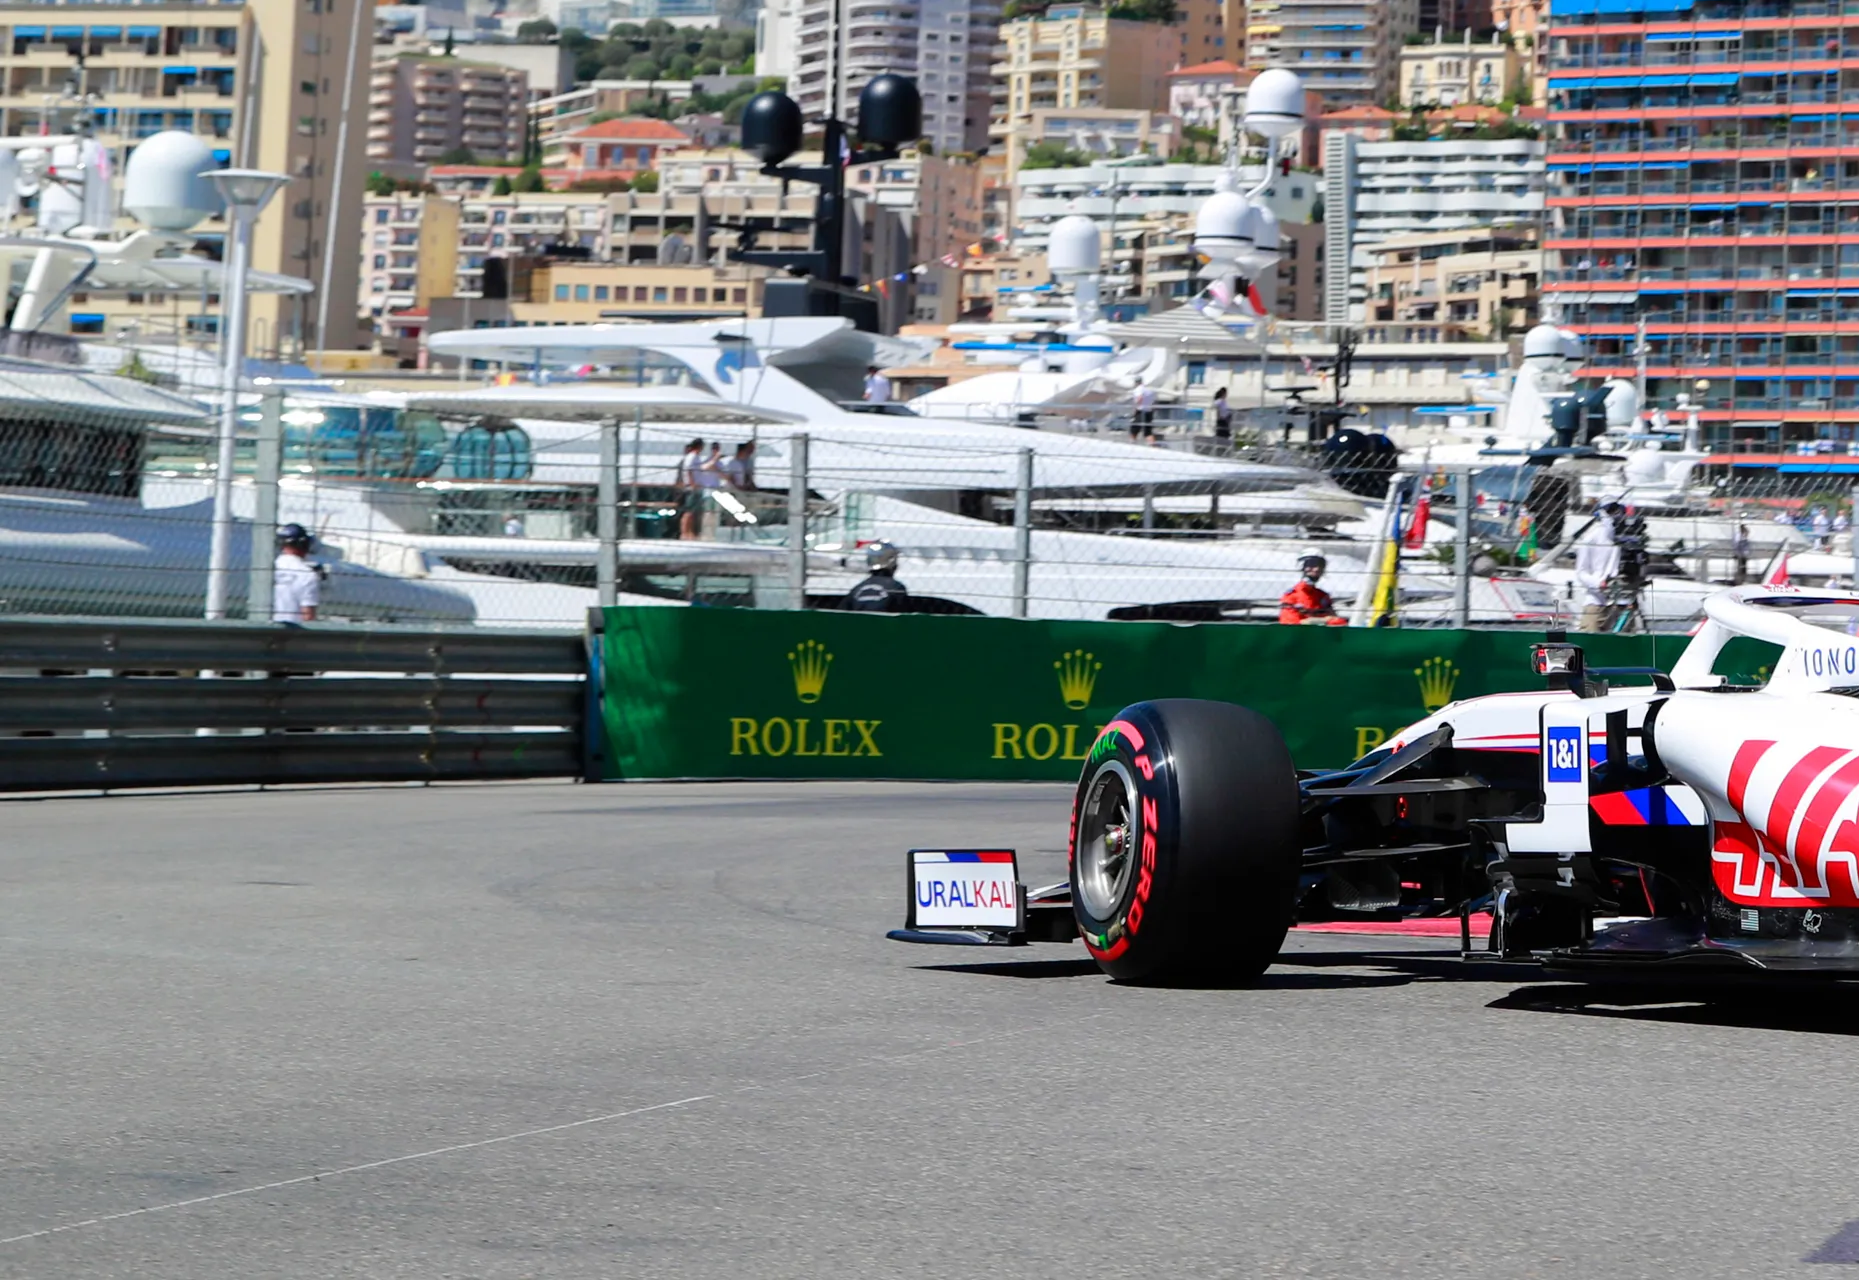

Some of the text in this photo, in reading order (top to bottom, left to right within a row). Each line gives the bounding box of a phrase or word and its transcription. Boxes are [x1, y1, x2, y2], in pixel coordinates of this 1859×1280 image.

[730, 717, 882, 757] ROLEX
[991, 723, 1107, 760] ROL
[1550, 739, 1579, 769] 1&1
[1127, 753, 1159, 935] P ZERO
[917, 880, 1015, 908] URALKALI
